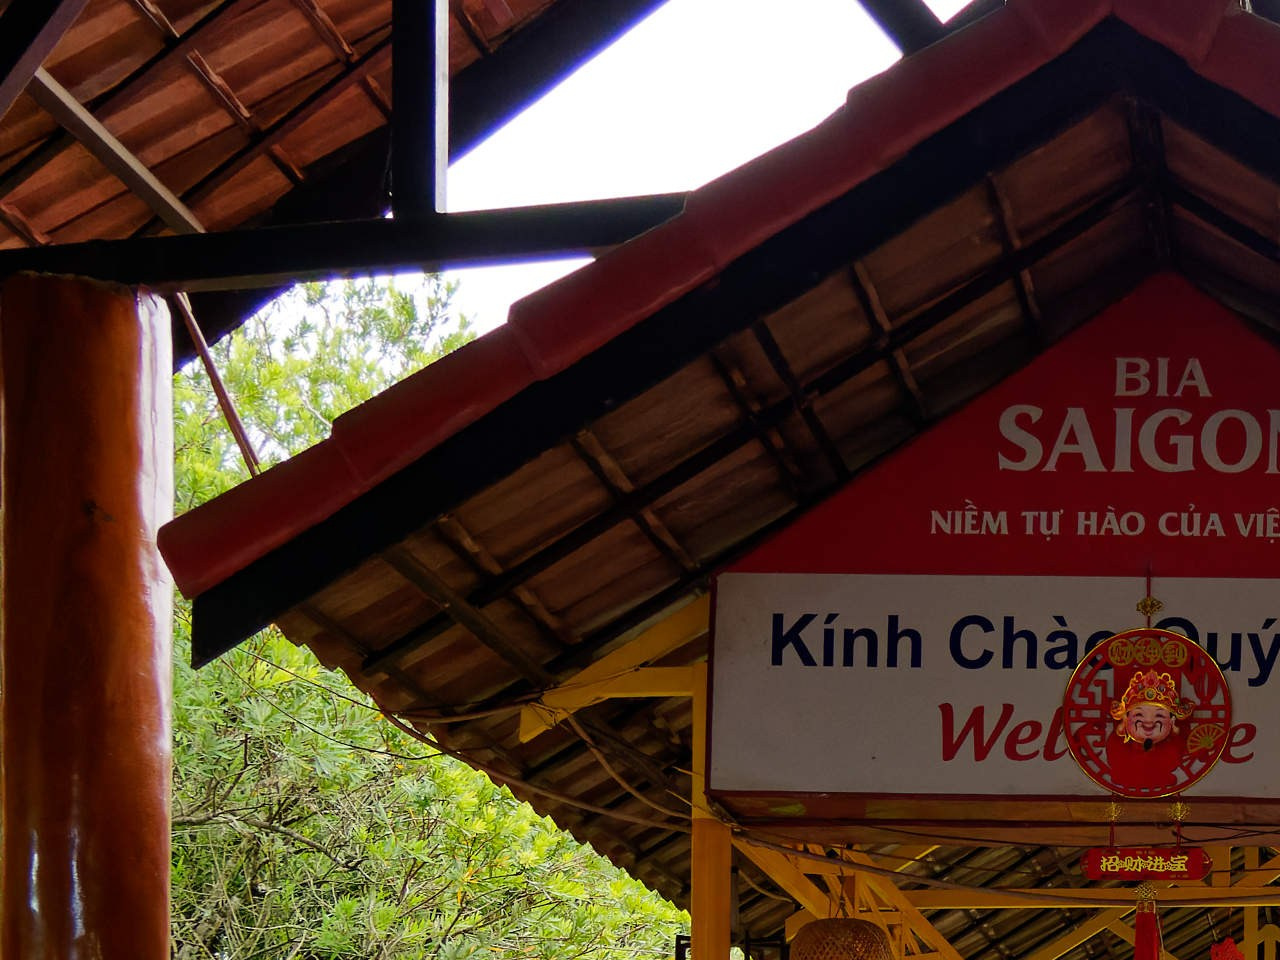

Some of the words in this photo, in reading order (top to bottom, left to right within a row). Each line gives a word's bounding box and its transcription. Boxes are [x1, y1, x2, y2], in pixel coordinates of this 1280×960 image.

[1115, 358, 1211, 397] BIA
[930, 499, 1009, 535] NIỀM
[1021, 508, 1064, 540] TỰ
[1076, 505, 1146, 535] HÀO
[1158, 503, 1226, 536] CỦA
[770, 611, 923, 670] Kính
[938, 701, 1257, 764] Wele
[1100, 854, 1189, 873] 招财进宝
